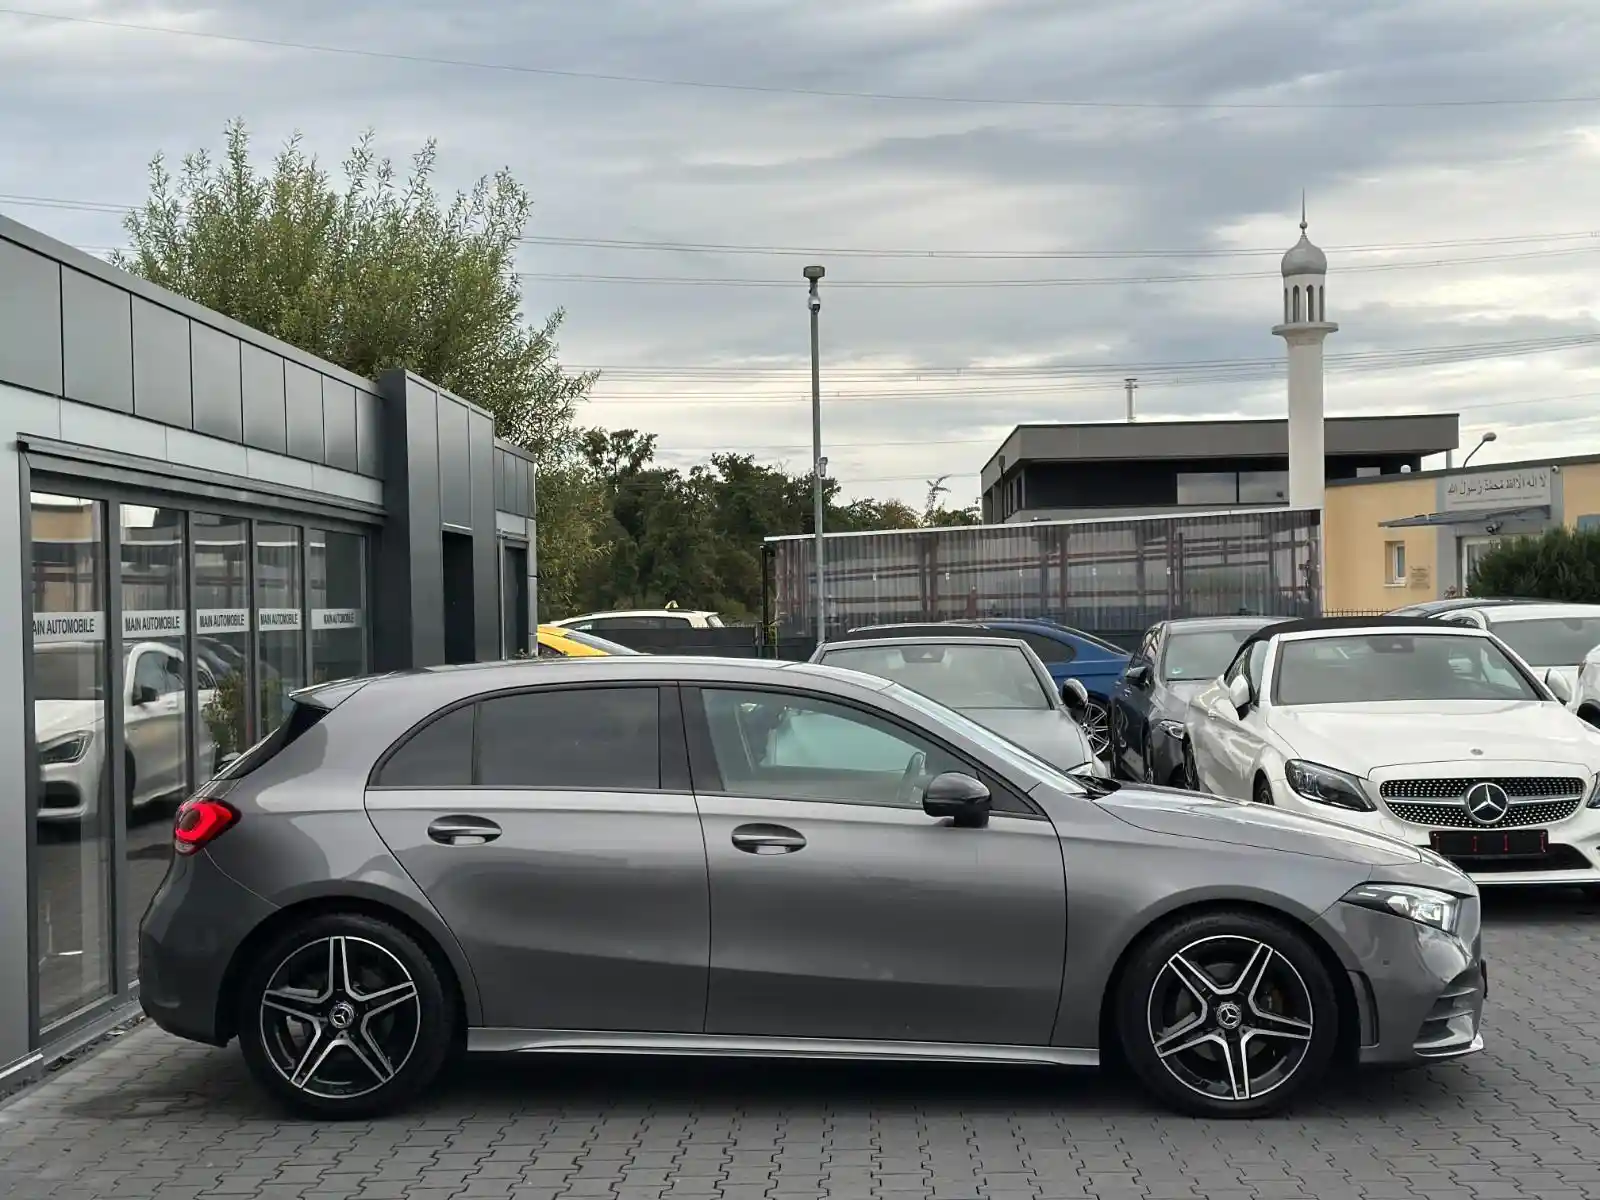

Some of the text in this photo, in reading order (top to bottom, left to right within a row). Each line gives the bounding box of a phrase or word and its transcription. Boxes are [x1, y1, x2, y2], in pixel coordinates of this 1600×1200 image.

[125, 615, 180, 632] MAIN AUTOMOBILE
[200, 614, 245, 628] MAIN AUTOMOBILE
[260, 612, 298, 625] MAIN AUTOMOBILE
[32, 618, 95, 635] AIN AUTOMOBILE
